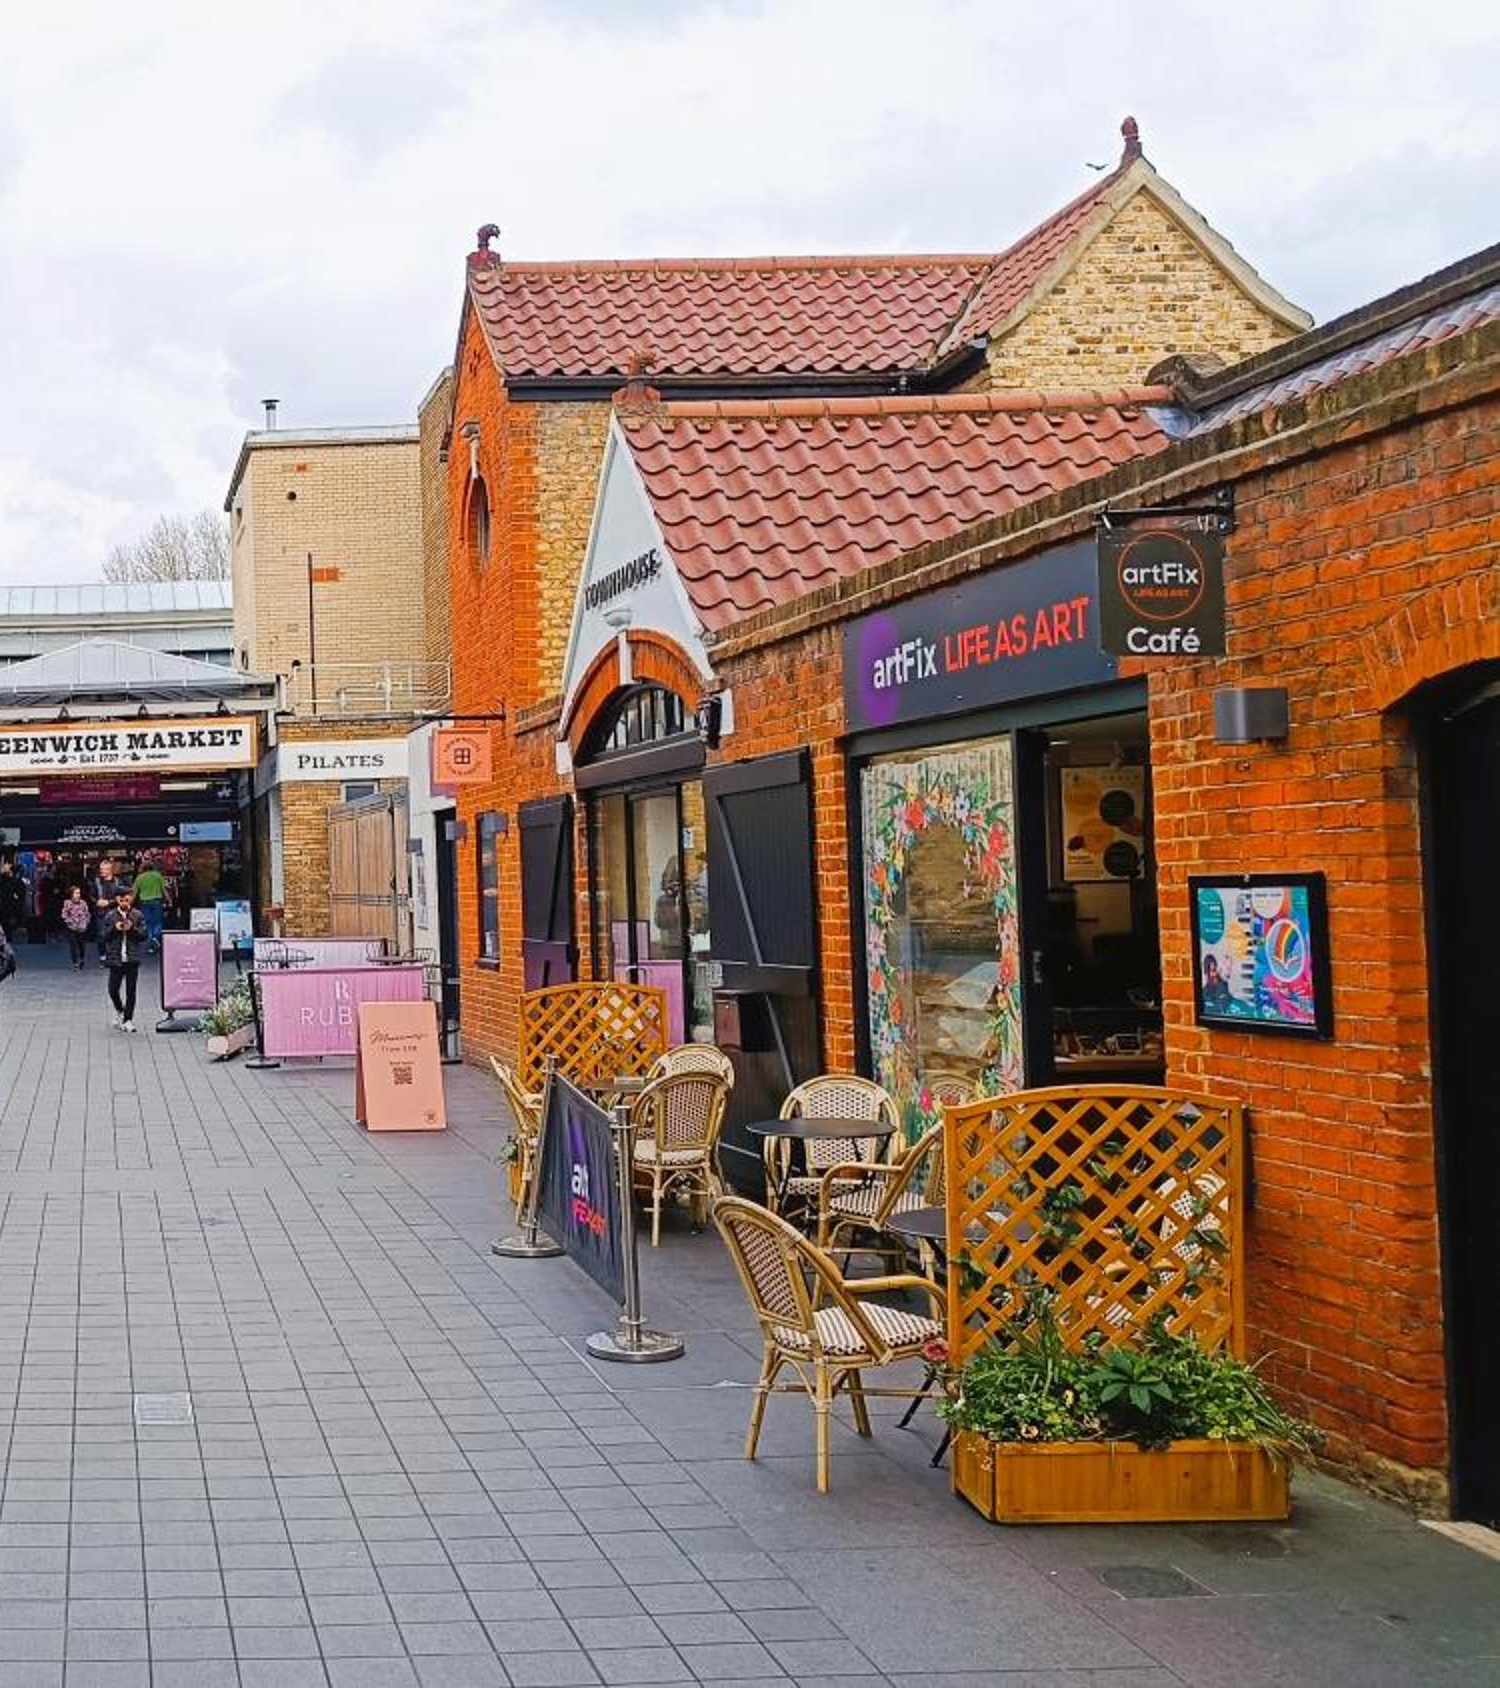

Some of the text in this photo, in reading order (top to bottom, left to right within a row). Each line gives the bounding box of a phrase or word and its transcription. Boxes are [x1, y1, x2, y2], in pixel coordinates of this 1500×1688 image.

[1123, 563, 1199, 585] artFix
[873, 595, 1090, 689] artFix LIFE AS ART
[1127, 627, 1200, 653] Café
[127, 729, 243, 750] MARKET
[99, 753, 119, 763] 1737
[301, 1006, 353, 1026] RUB
